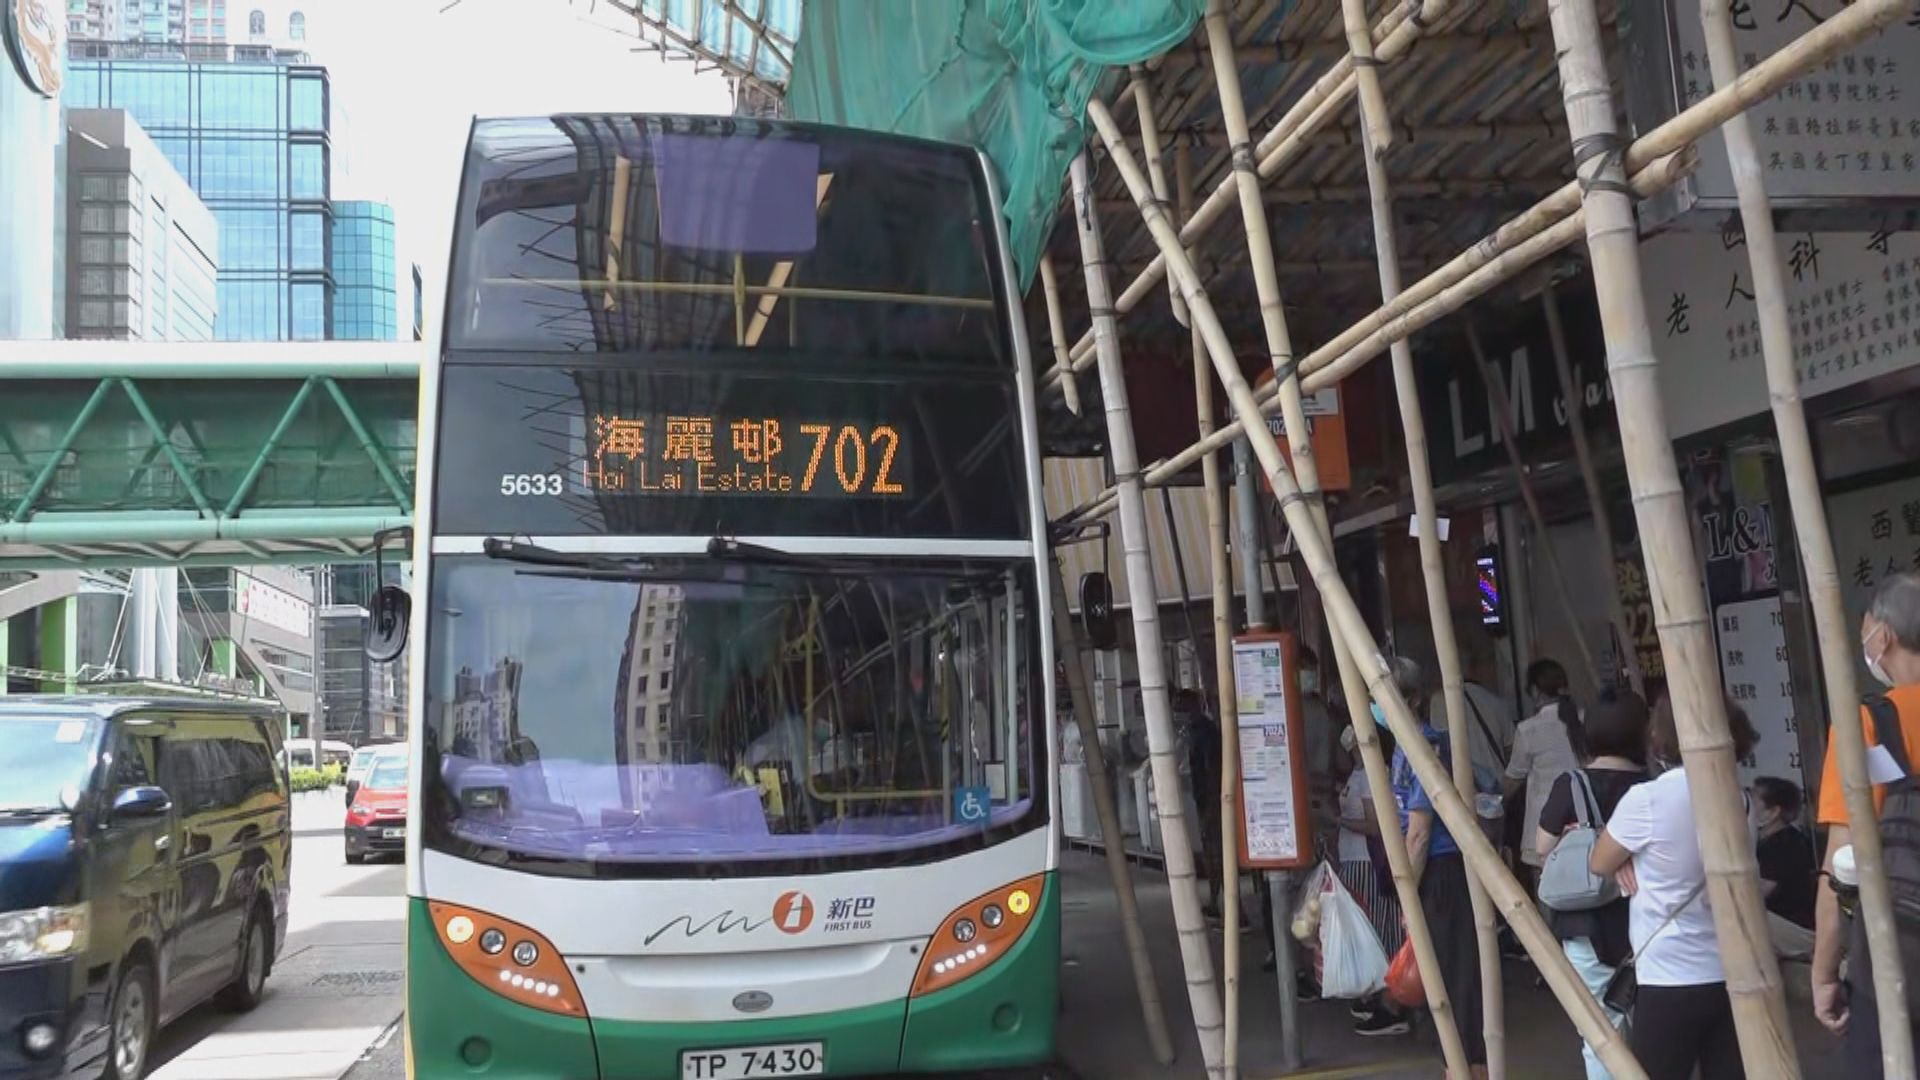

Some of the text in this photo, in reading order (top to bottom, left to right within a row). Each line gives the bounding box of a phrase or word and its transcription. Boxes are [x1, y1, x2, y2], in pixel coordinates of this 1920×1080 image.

[1448, 346, 1536, 458] LM
[594, 415, 903, 493] 海麗邨 702
[500, 474, 563, 496] 5633
[583, 459, 793, 492] Hoi Lai Estate
[827, 897, 875, 920] 新巴
[824, 920, 872, 932] FIRST BUS
[690, 1048, 815, 1079] TP 7430
